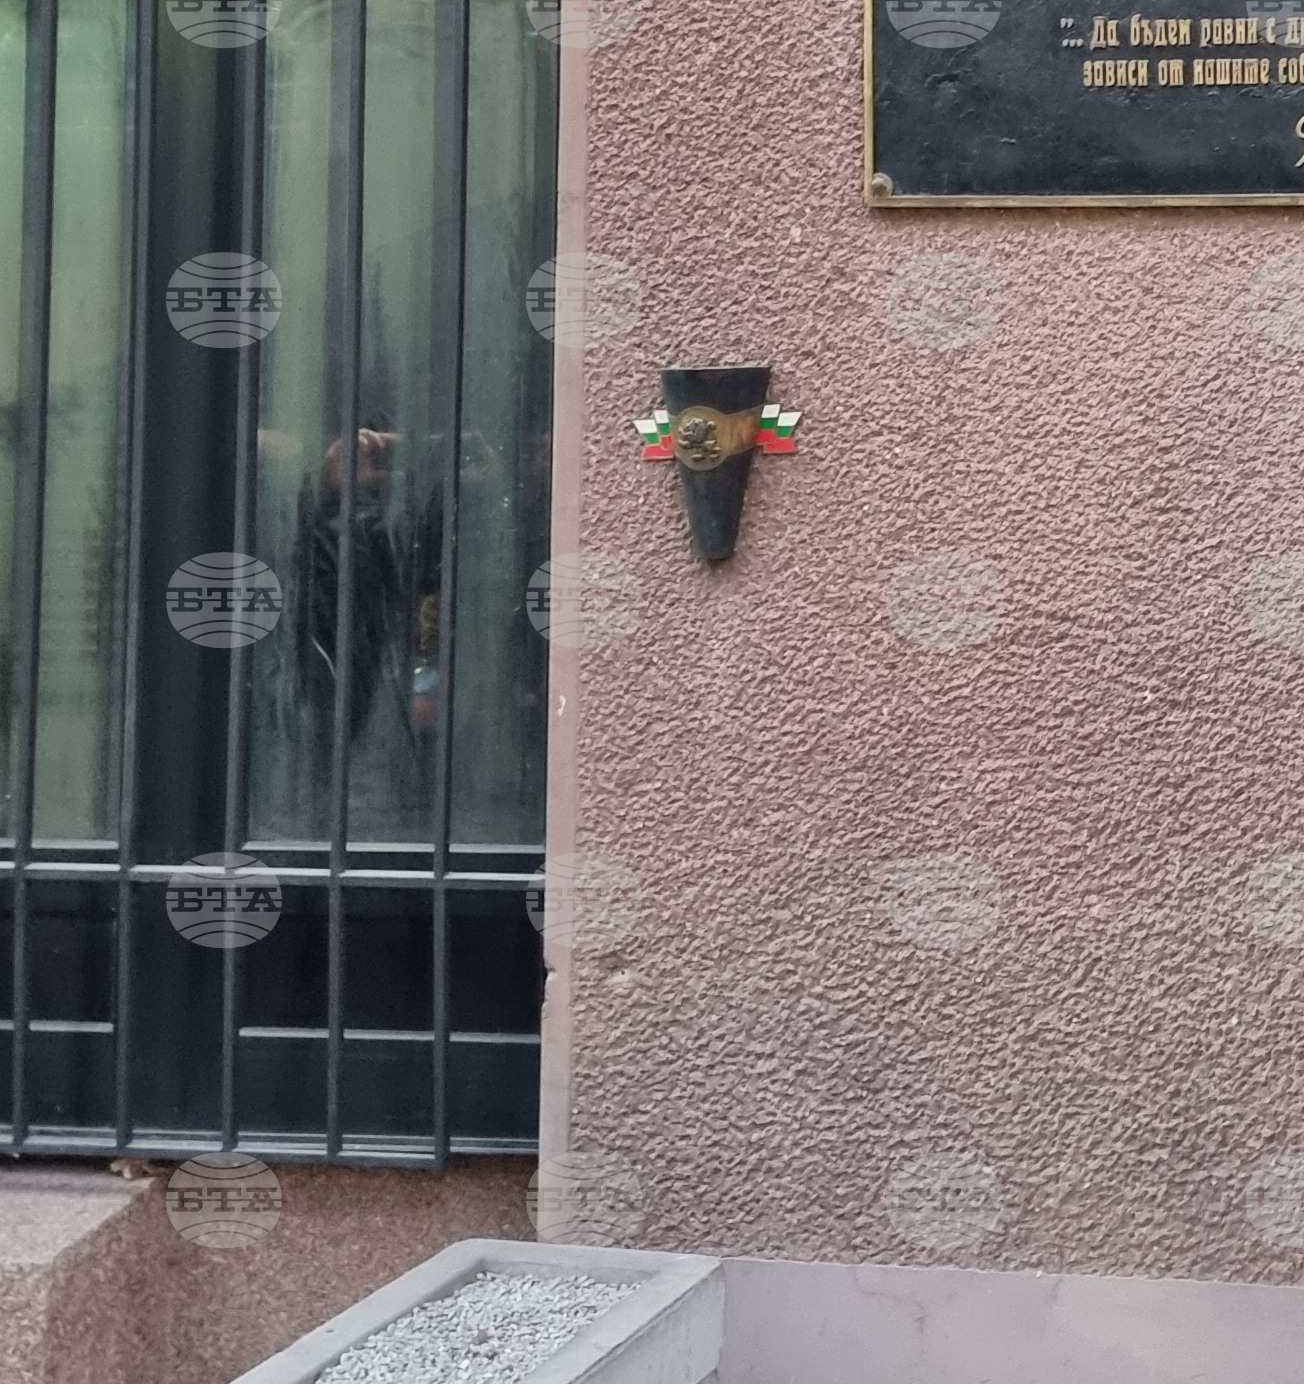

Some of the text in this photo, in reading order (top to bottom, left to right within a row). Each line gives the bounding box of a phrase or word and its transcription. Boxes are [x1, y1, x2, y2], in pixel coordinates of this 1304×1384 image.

[1130, 13, 1192, 47] бъдем
[1200, 17, 1258, 48] равни
[1083, 59, 1149, 87] зависи
[1157, 59, 1184, 87] от
[1193, 58, 1270, 87] нашите
